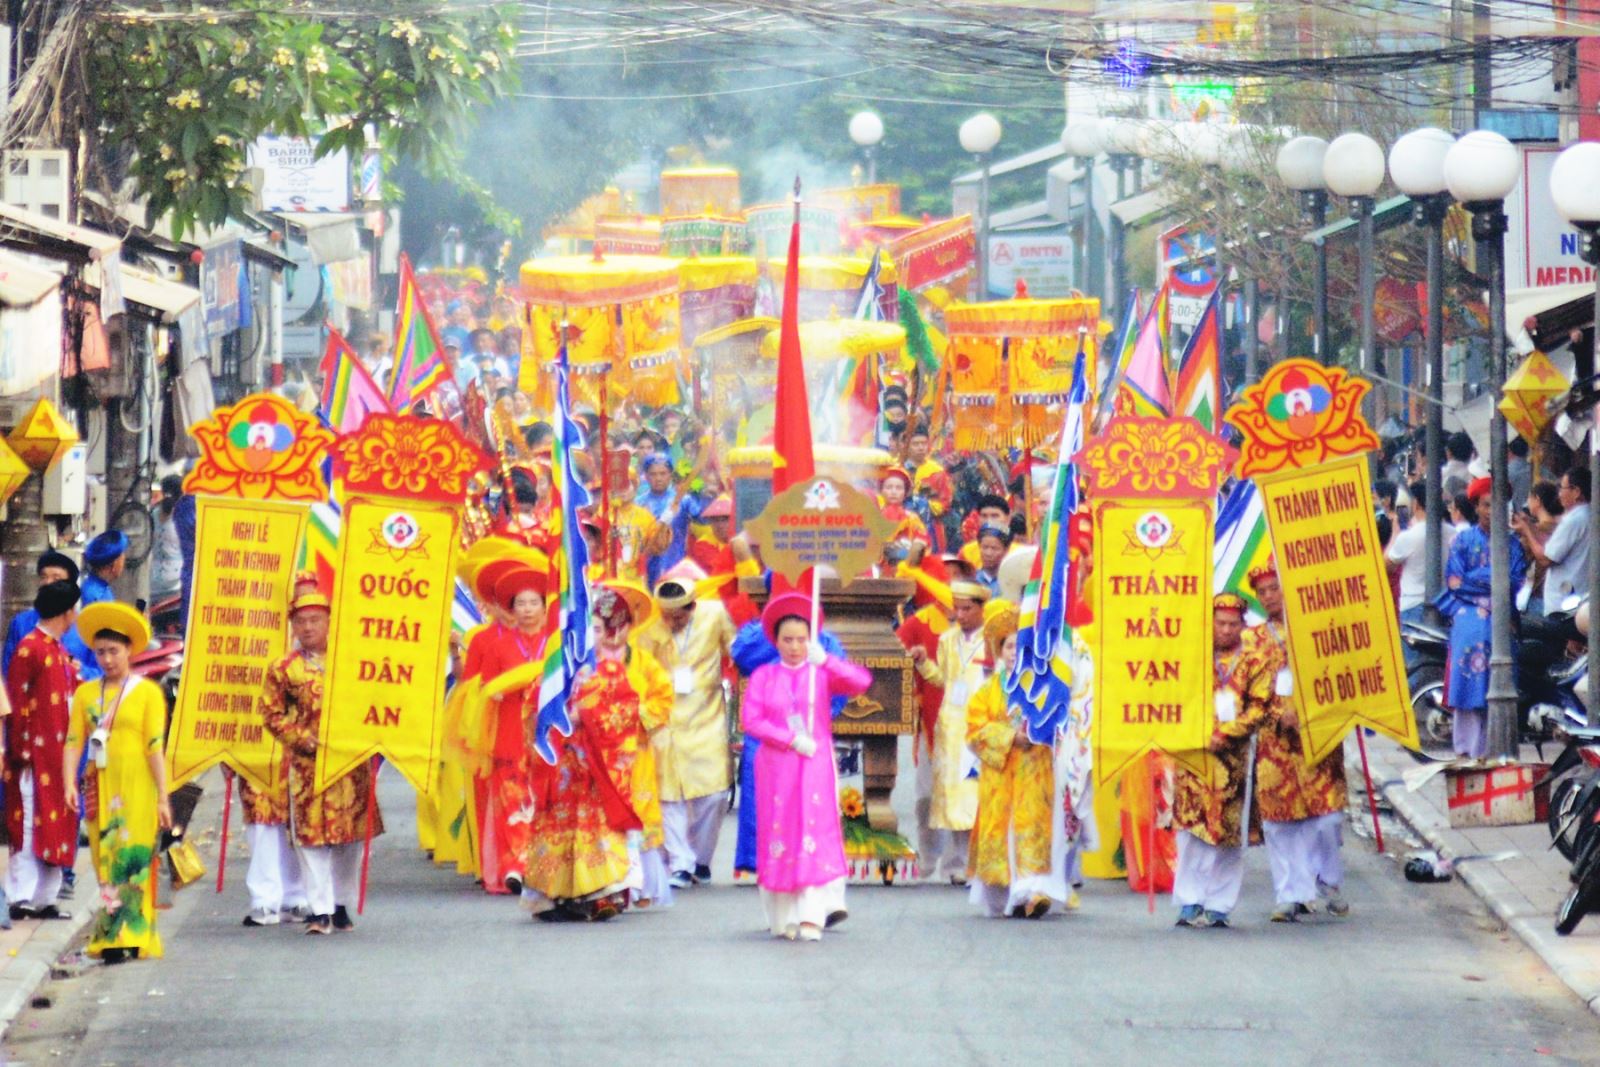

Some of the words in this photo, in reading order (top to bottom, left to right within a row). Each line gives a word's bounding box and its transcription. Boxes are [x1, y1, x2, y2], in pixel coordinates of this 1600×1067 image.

[1322, 478, 1359, 515] KÍNH
[1283, 532, 1338, 570] NGHINH
[1340, 521, 1367, 558] GIÁ
[241, 550, 281, 573] NGHINH
[359, 568, 430, 599] QUỐC
[1109, 569, 1198, 595] THÁNH
[1345, 574, 1370, 609] MẸ
[359, 615, 421, 643] THÁI
[1125, 606, 1182, 638] MẪU
[1351, 620, 1372, 650] DU
[206, 634, 223, 654] 352
[358, 656, 414, 686] DÂN
[1126, 660, 1180, 687] VẠN
[1313, 665, 1334, 706] CỐ
[1357, 656, 1387, 697] HUẾ
[363, 704, 401, 728] AN
[1122, 703, 1182, 724] LINH
